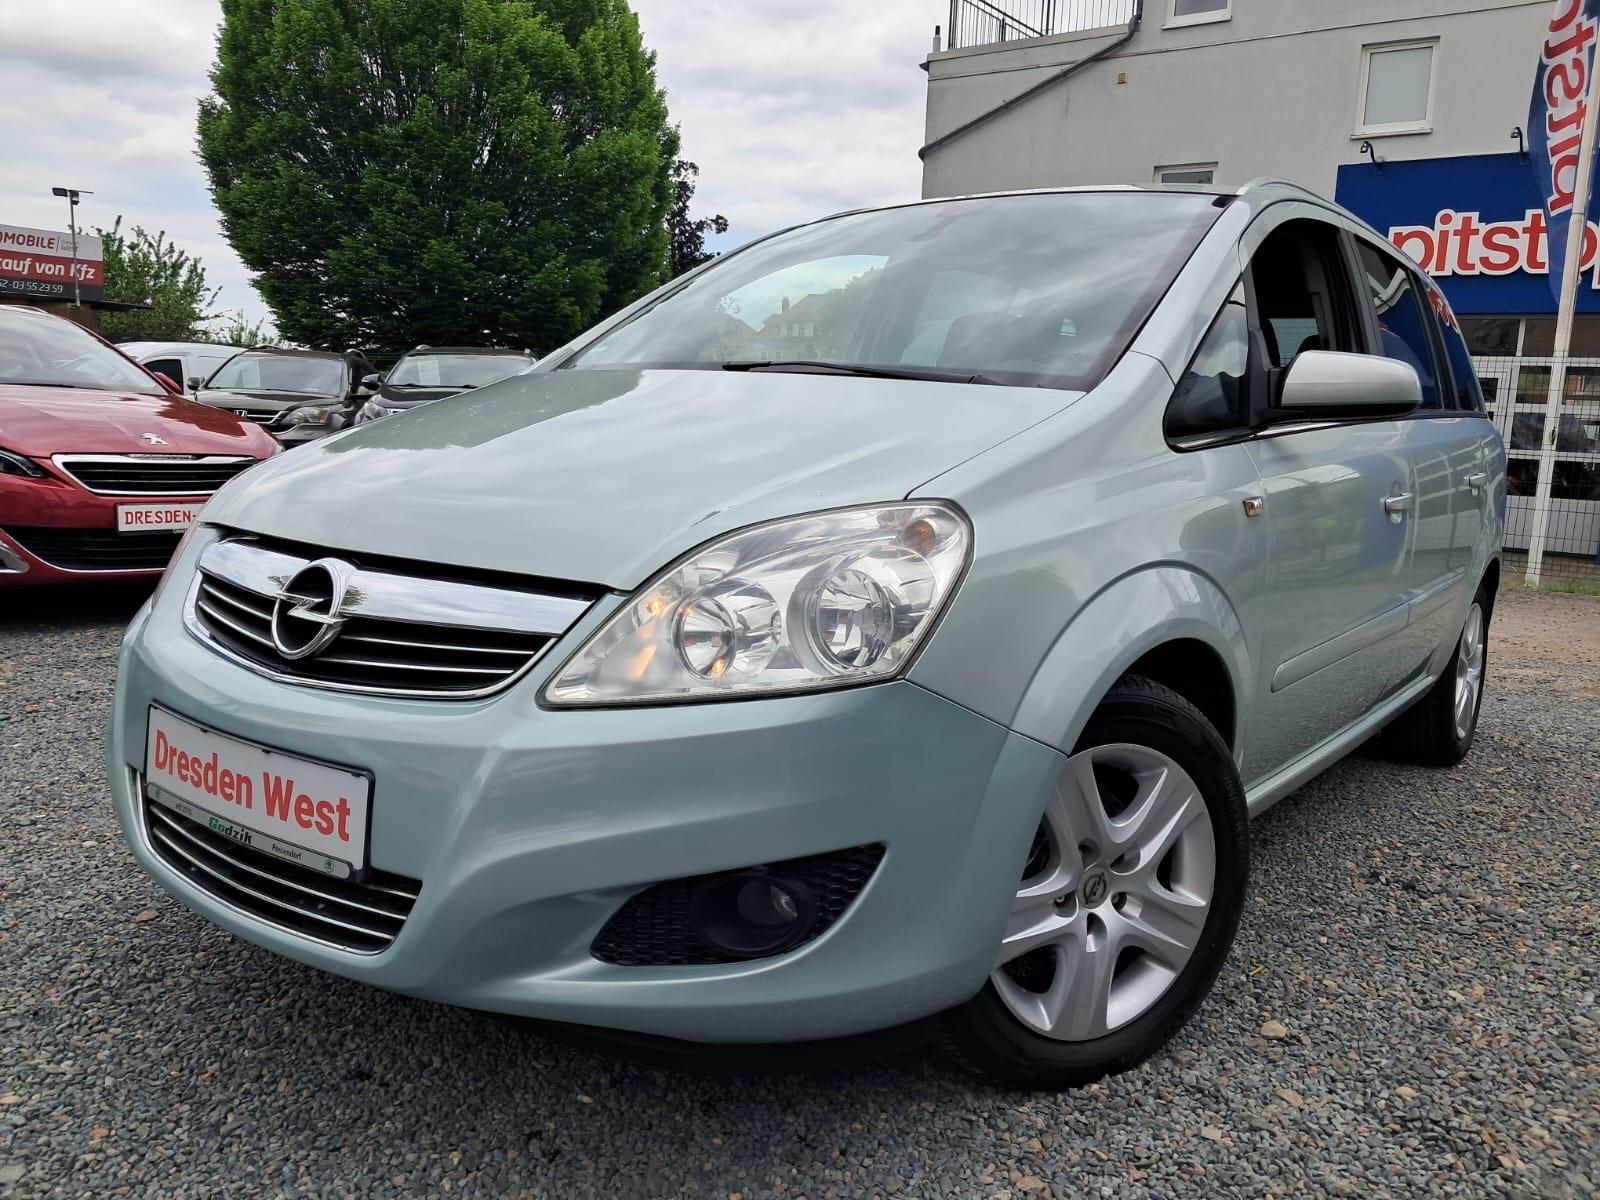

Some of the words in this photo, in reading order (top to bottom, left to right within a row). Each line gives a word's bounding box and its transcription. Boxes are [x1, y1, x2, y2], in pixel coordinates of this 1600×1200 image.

[0, 231, 56, 249] MOBILE
[0, 257, 33, 275] auf
[36, 262, 65, 276] von
[69, 263, 96, 281] Kfz
[155, 729, 253, 810] Dresden
[262, 771, 351, 842] West
[208, 816, 253, 845] Godzik
